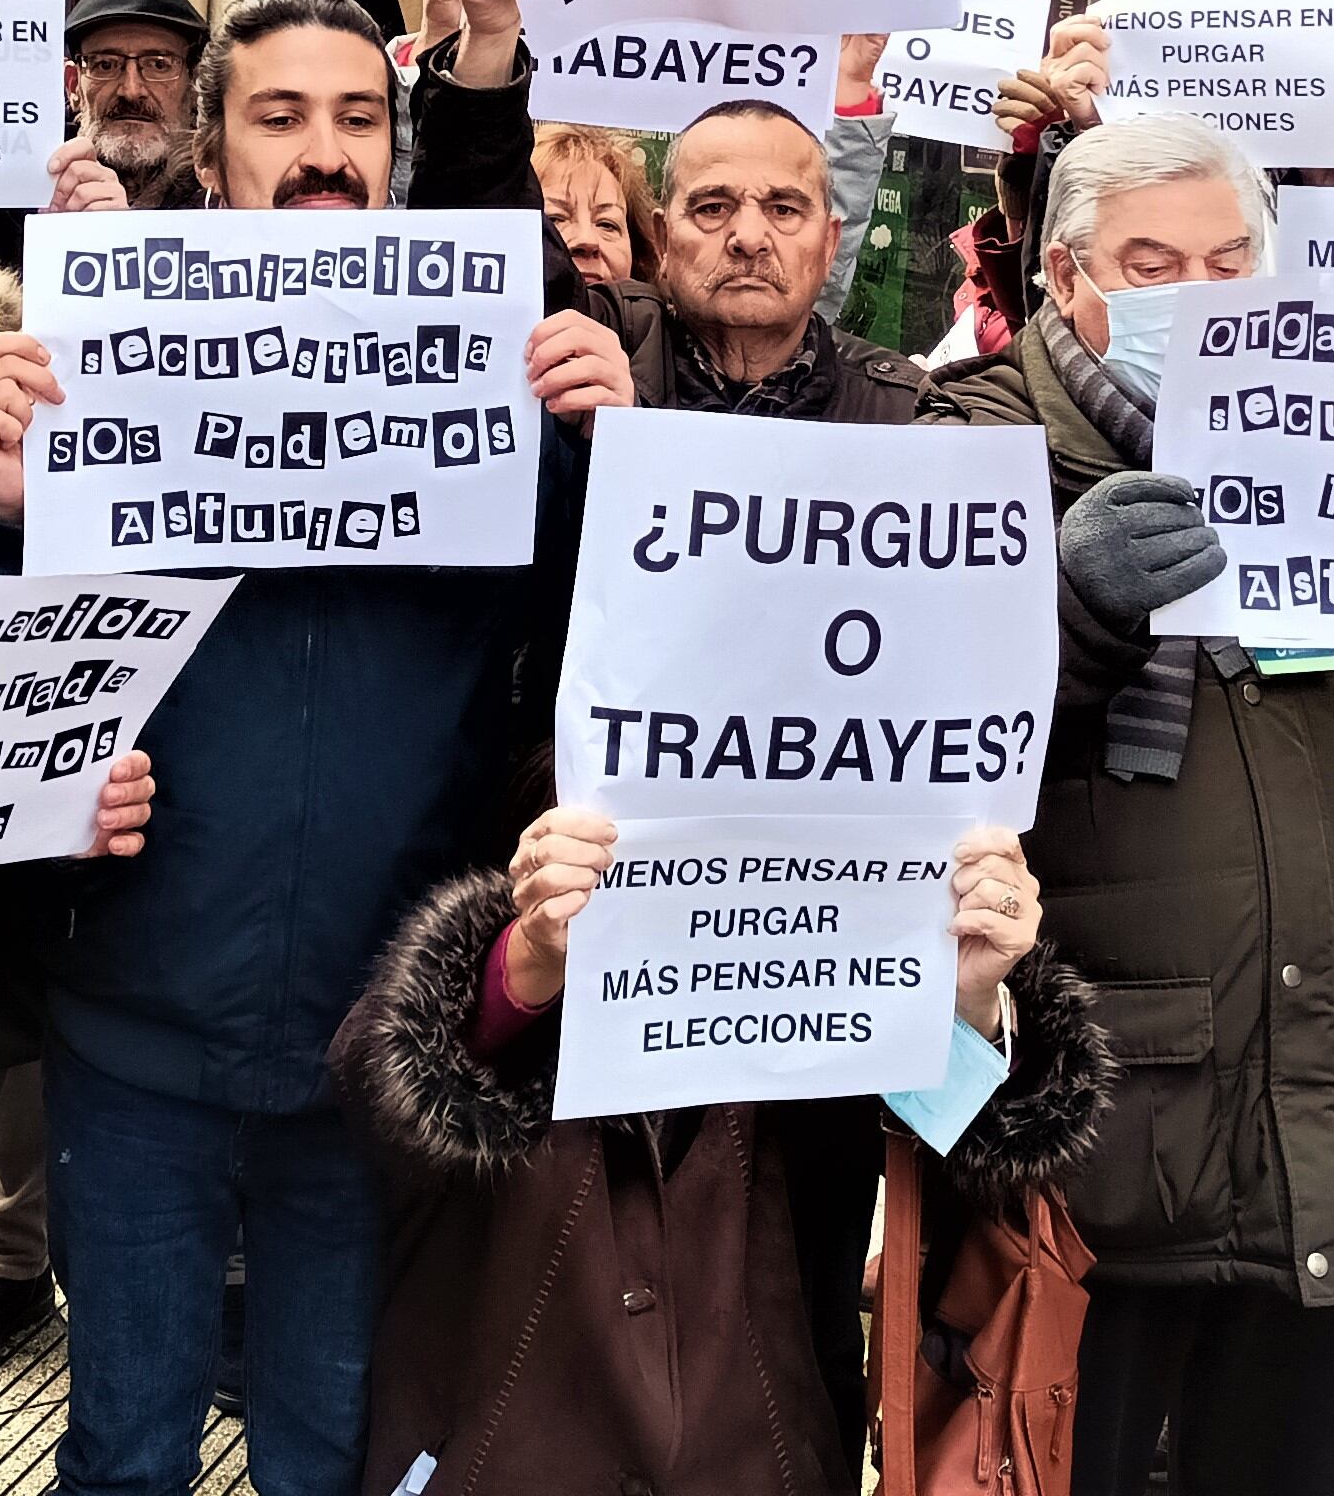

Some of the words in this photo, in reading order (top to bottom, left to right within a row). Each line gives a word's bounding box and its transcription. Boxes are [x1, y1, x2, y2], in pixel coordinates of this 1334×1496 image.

[12, 20, 48, 43] EN
[1191, 9, 1291, 28] PENSAR
[1301, 8, 1333, 28] EN
[553, 35, 818, 87] ABAYES?
[906, 37, 931, 61] O
[1162, 44, 1265, 63] PURGAR
[1105, 74, 1159, 97] MÁS
[1168, 78, 1266, 97] PENSAR
[1275, 78, 1325, 97] NES
[877, 188, 902, 215] VEGA
[81, 324, 493, 386] secuestrada
[194, 405, 515, 470] Podemos
[111, 491, 420, 551] Asturies
[634, 490, 1027, 572] ¿PURGUES
[824, 609, 881, 676] O
[590, 706, 1035, 783] TRABAYES?
[595, 856, 727, 889] MENOS
[738, 856, 887, 885] PENSAR
[896, 861, 947, 883] EN
[689, 904, 839, 937] PURGAR
[602, 961, 679, 1001] MÁS
[690, 958, 836, 993] PENSAR
[848, 956, 922, 987] NES
[642, 1011, 872, 1052] ELECCIONES
